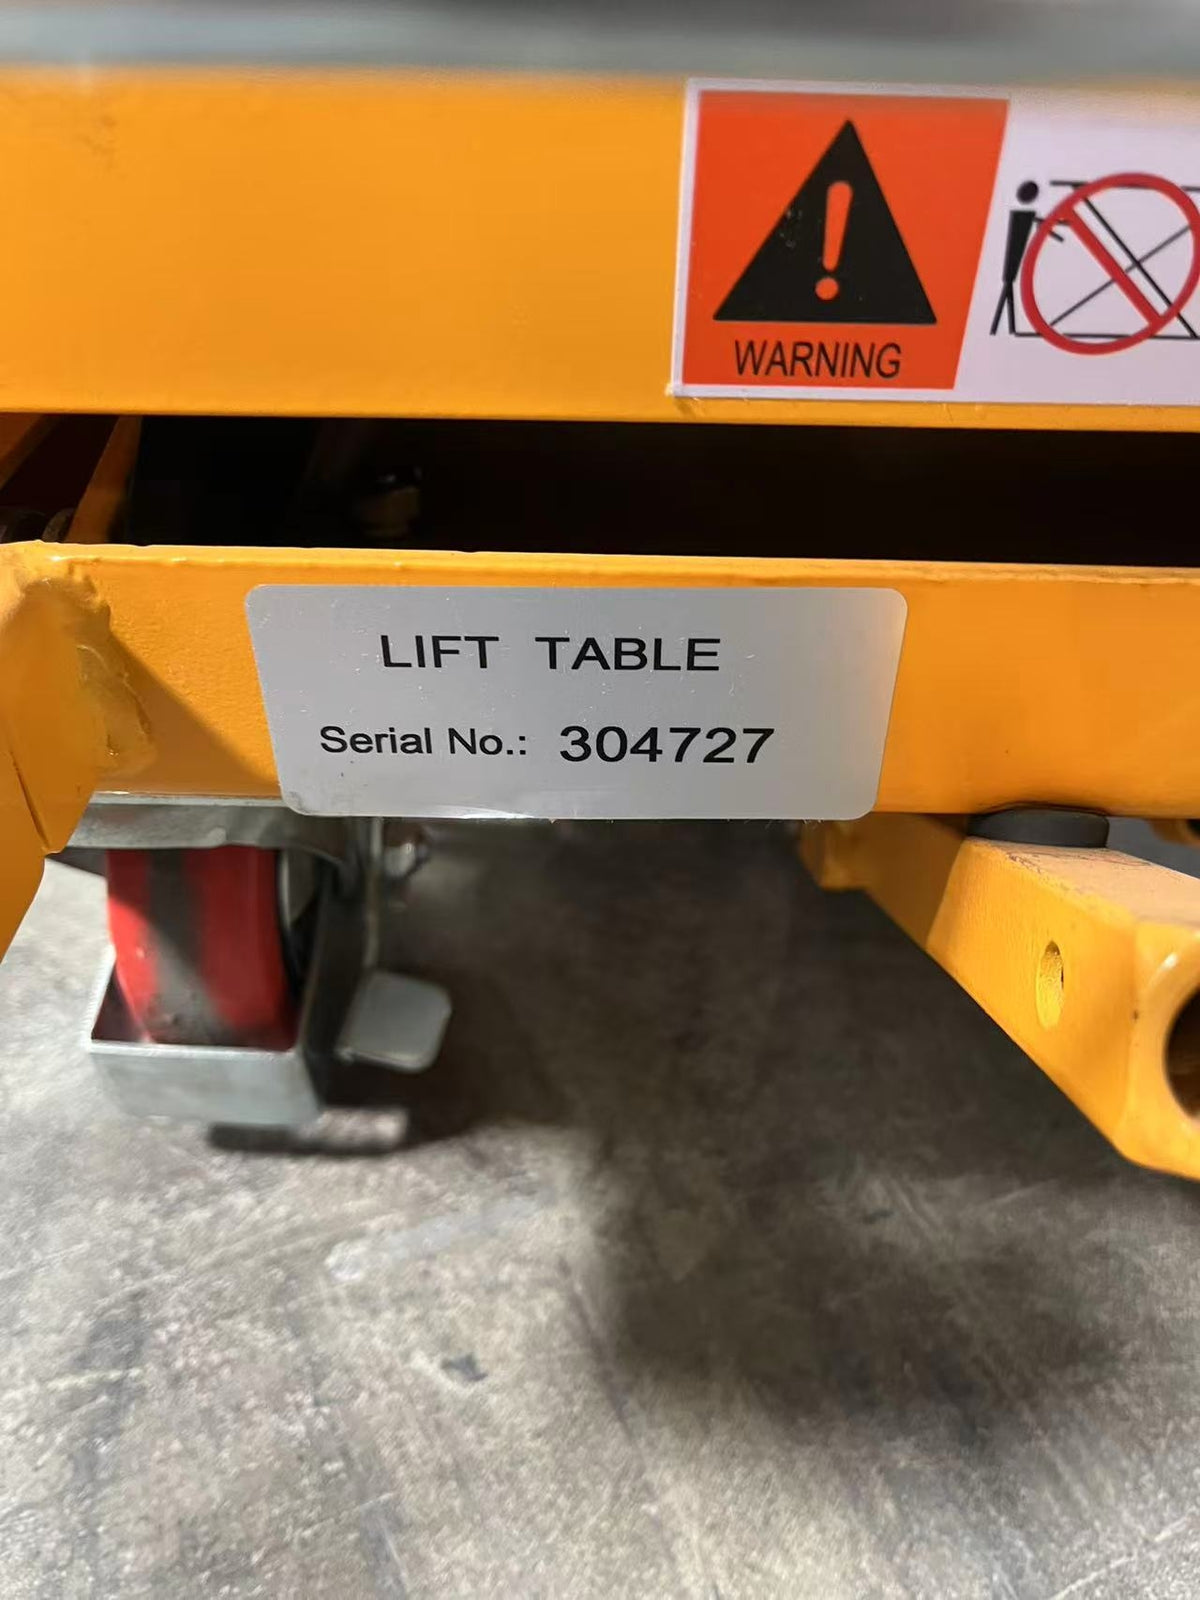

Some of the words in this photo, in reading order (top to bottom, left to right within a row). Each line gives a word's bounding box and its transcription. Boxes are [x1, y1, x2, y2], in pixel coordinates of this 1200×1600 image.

[734, 338, 903, 380] WARNING
[380, 634, 500, 669] LIFT
[534, 636, 721, 672] TABLE
[320, 725, 433, 755] Serial
[447, 727, 527, 757] No.:
[559, 725, 775, 764] 304727
